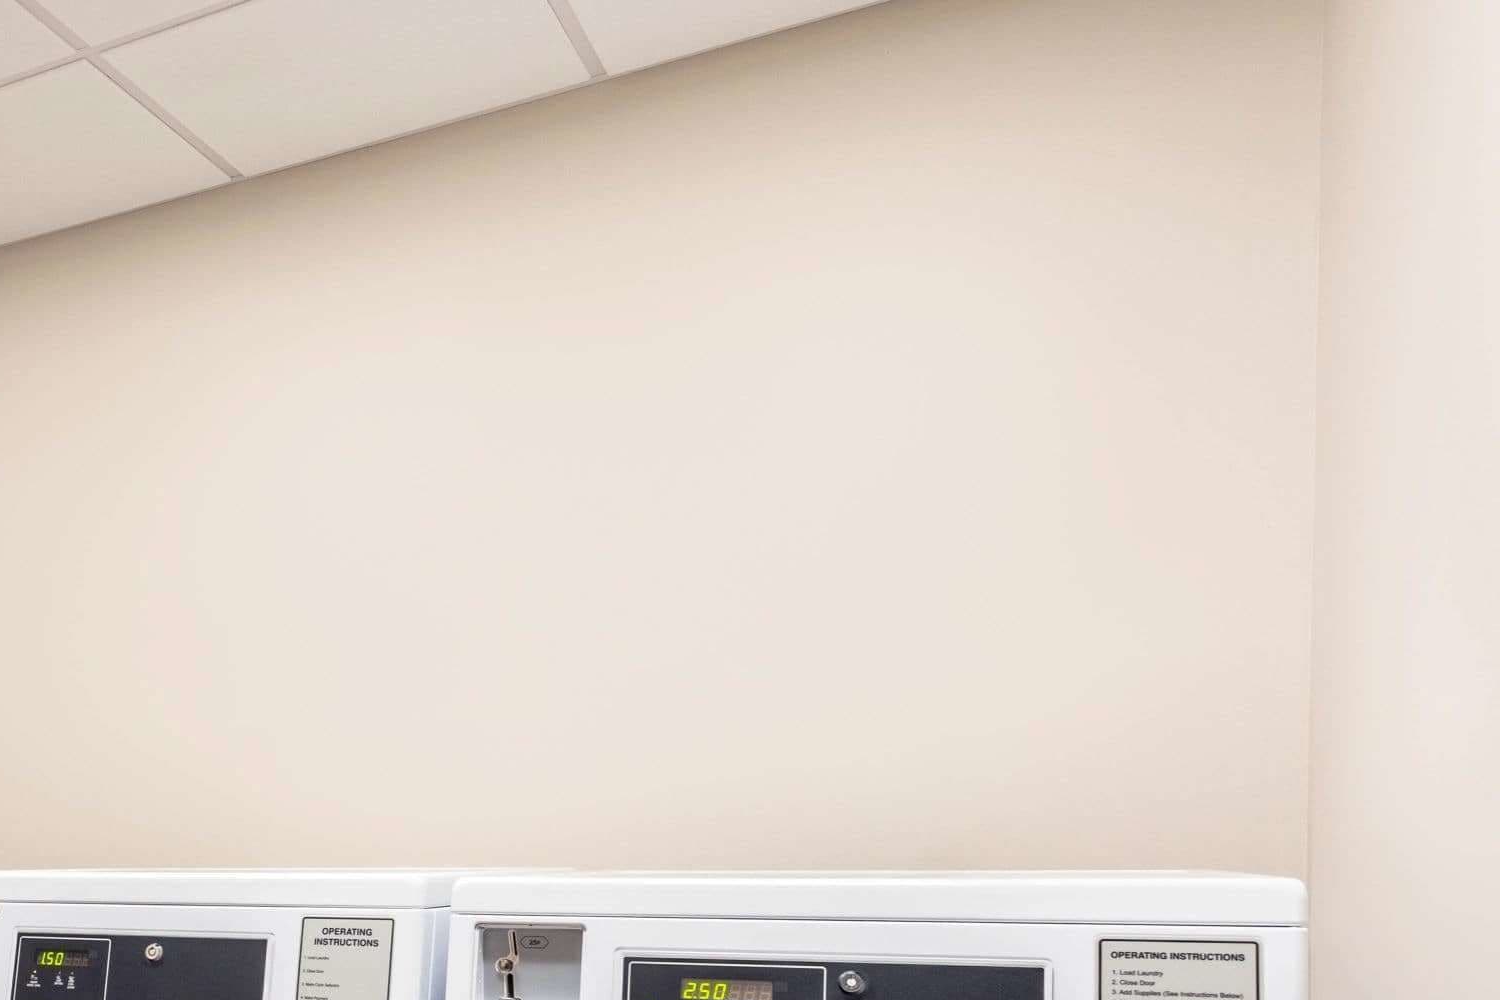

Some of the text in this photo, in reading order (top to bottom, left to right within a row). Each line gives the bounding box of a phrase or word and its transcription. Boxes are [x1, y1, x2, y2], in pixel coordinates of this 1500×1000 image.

[322, 928, 372, 936] OPERATING
[314, 938, 379, 947] INSTRUCTIONS
[1111, 951, 1245, 962] OPERATING INSTRUCTIONS
[683, 982, 727, 1000] 2.50
[1134, 990, 1161, 998] Supplies
